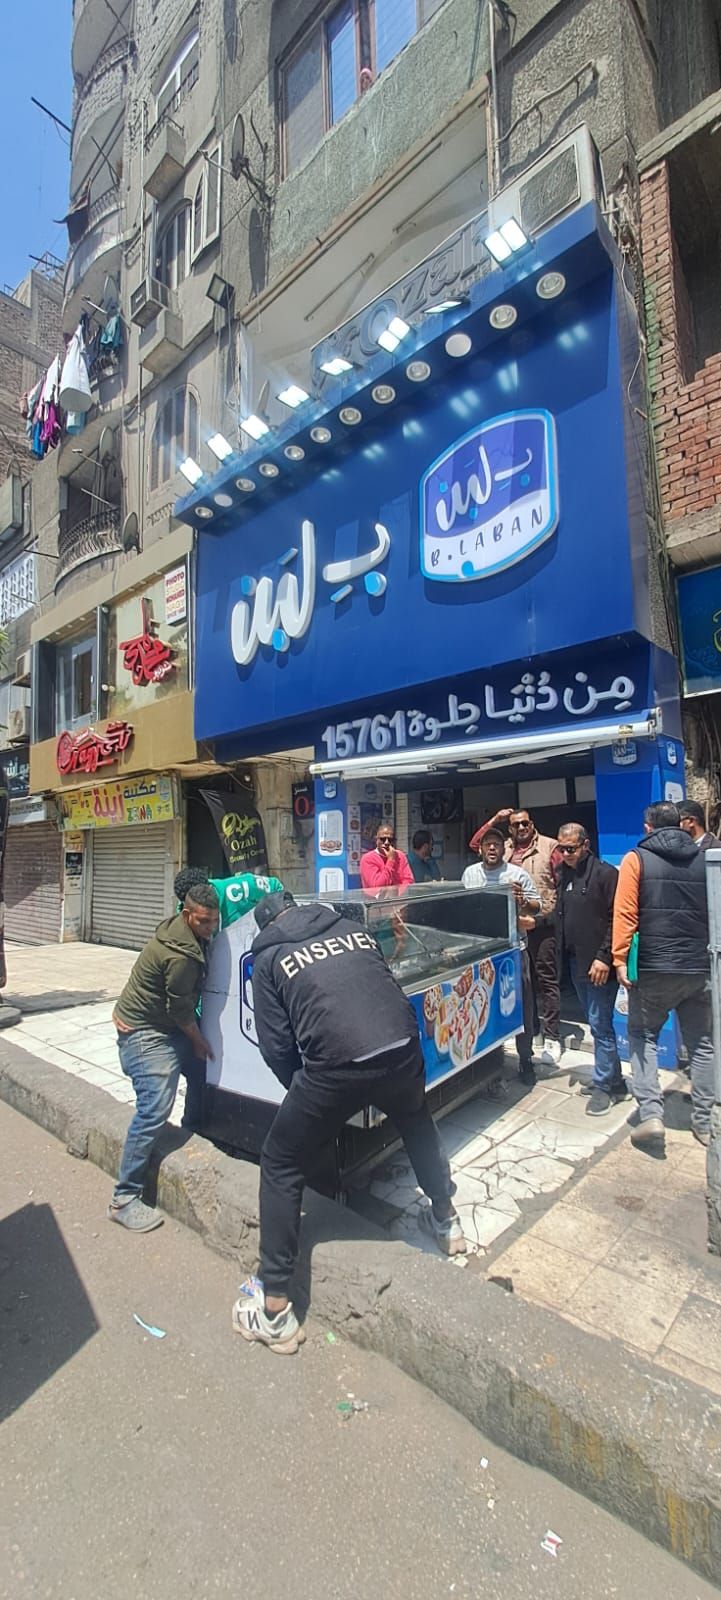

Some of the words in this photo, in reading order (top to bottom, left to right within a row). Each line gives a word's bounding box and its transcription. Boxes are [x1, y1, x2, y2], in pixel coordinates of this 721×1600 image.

[166, 571, 185, 587] PHOTO
[321, 710, 407, 759] 15761
[231, 835, 257, 851] Ozah
